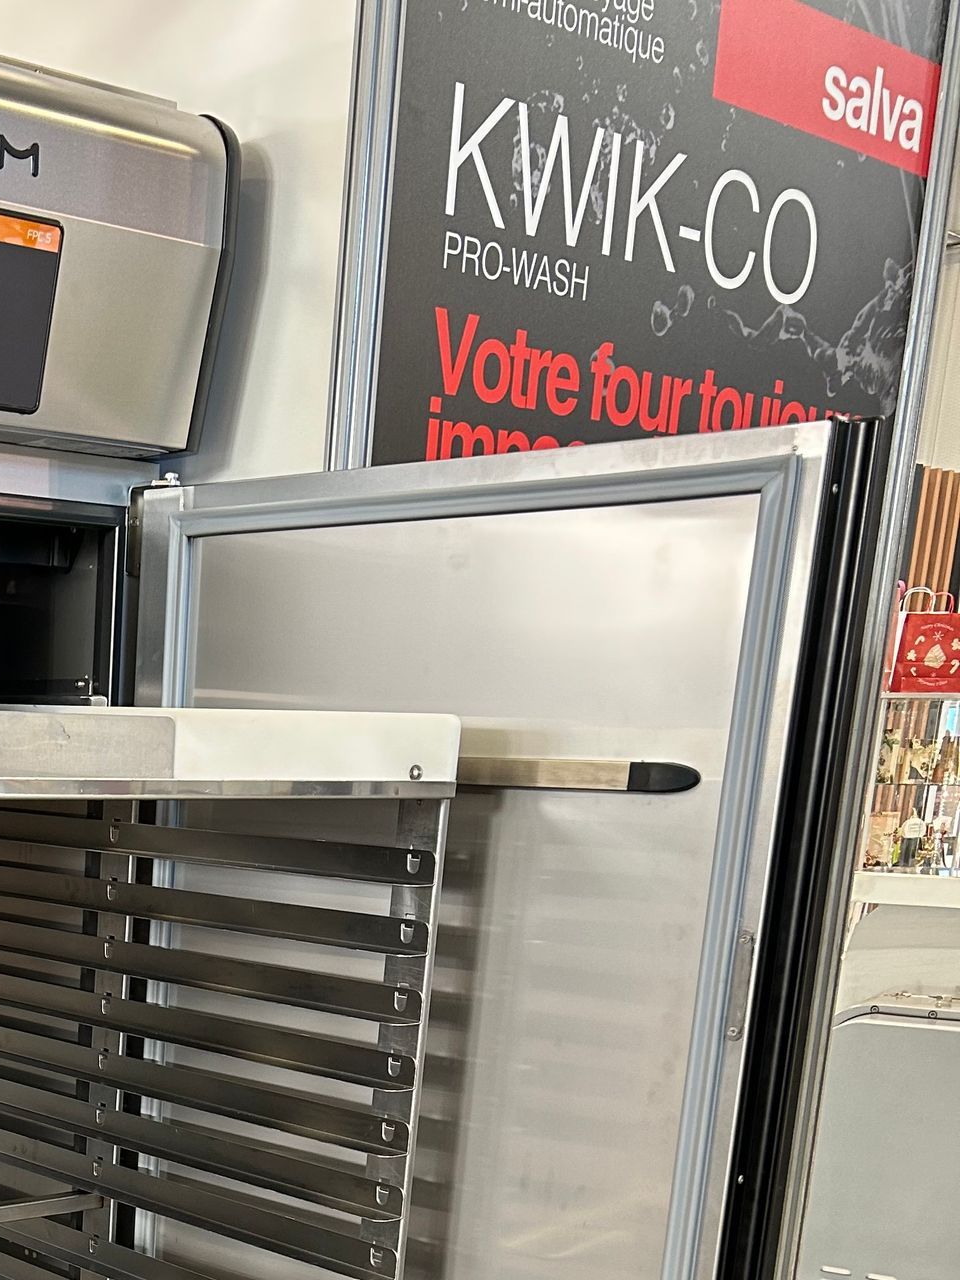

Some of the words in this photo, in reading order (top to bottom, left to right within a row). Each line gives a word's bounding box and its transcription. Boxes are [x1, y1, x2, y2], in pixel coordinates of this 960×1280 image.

[821, 66, 925, 153] salva
[444, 81, 819, 305] KWIK-CO
[443, 231, 590, 301] PRO-WASH
[435, 307, 580, 416] Votre
[590, 342, 693, 434] four
